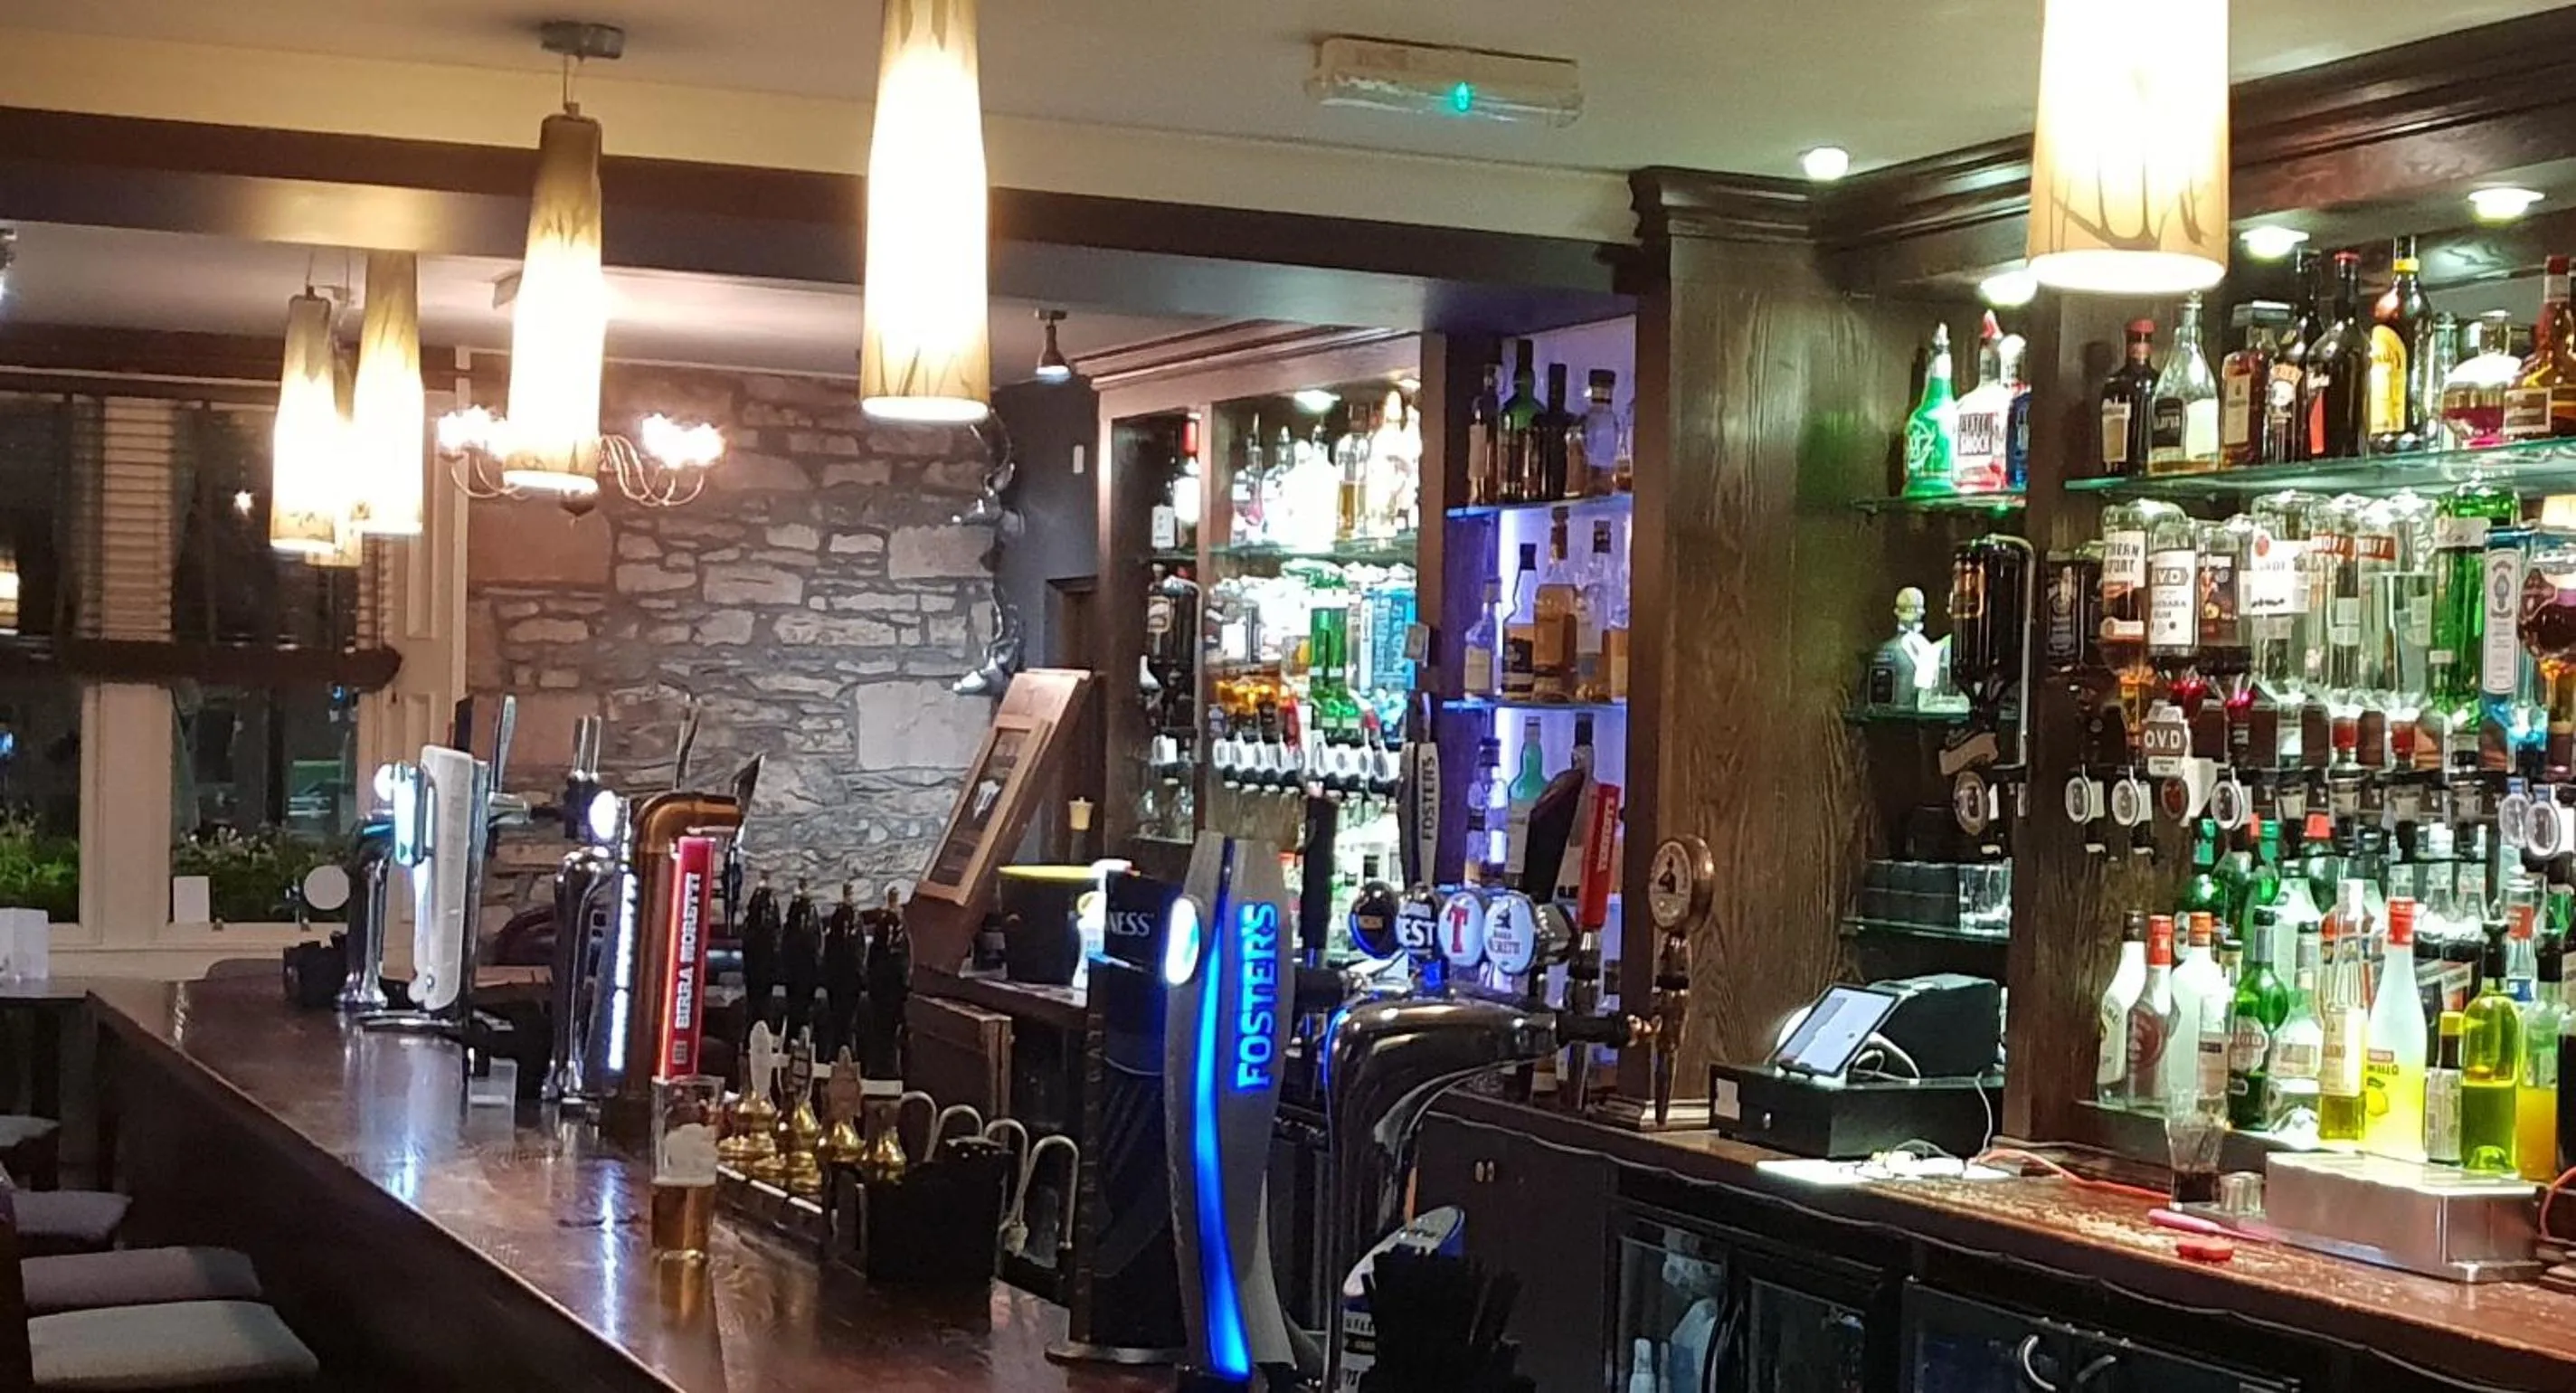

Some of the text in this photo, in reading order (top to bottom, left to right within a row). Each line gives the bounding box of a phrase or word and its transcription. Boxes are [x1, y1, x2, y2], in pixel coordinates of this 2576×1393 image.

[2144, 729, 2181, 750] OVD
[1420, 755, 1436, 840] FOSTER'S
[680, 873, 700, 962] MORETTI
[1107, 911, 1151, 936] NESS
[1398, 917, 1436, 948] EST
[675, 968, 694, 1028] BIRRA
[1237, 905, 1275, 1088] FOSTER'S
